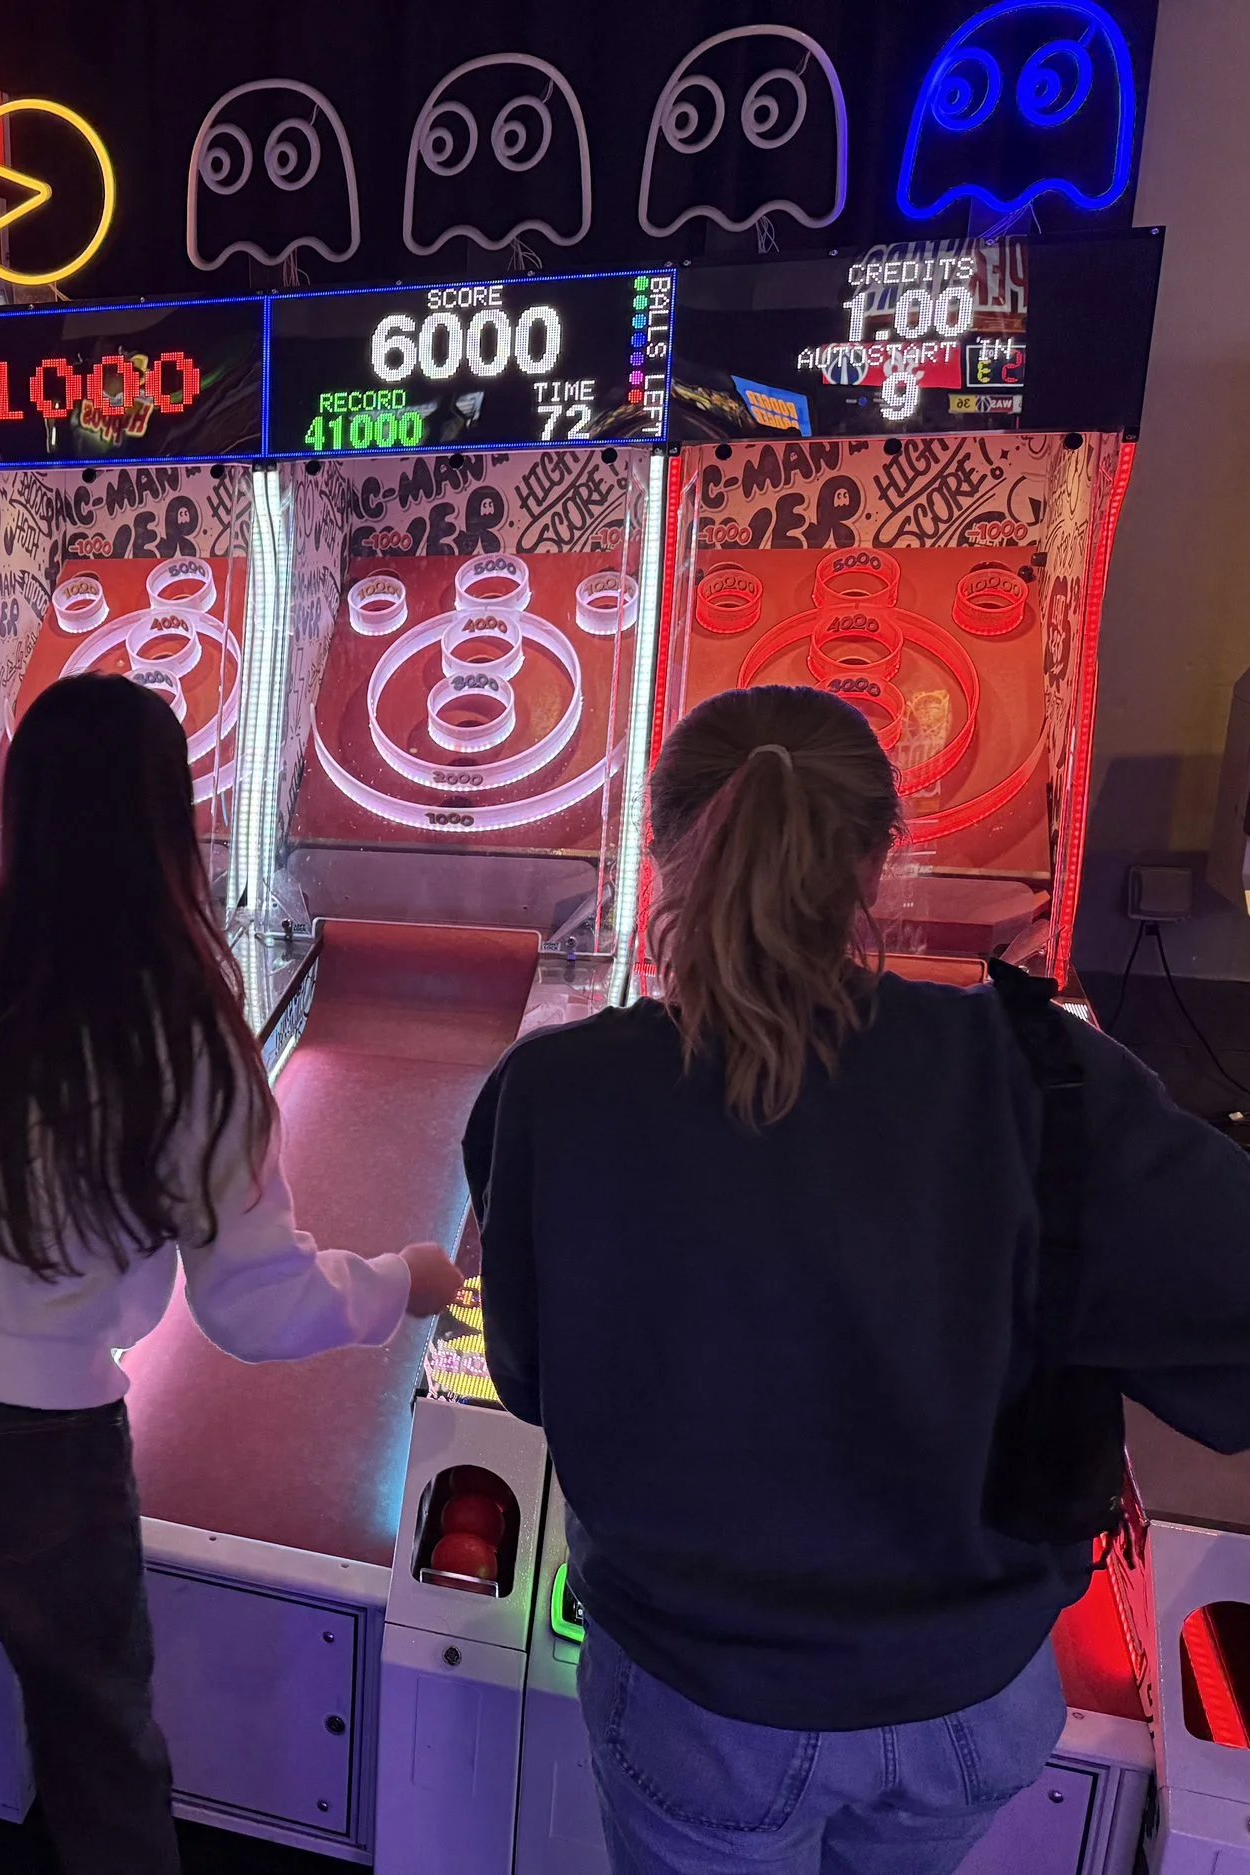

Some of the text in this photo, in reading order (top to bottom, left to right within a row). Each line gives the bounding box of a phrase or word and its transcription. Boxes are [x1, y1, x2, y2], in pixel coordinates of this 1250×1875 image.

[848, 257, 974, 286] CREDITS
[427, 285, 504, 308] SCORE
[842, 286, 974, 342] 1.00
[370, 305, 561, 382] 6000
[642, 276, 671, 437] BALLS LEFT
[797, 340, 957, 370] AUTOSTART
[318, 390, 407, 412] RECORD
[533, 379, 595, 403] TIME
[880, 371, 919, 421] 9
[304, 411, 423, 451] 41000
[535, 402, 591, 441] 72
[362, 529, 413, 551] -1000
[965, 519, 1029, 541] -1000
[68, 536, 112, 556] -1000
[168, 561, 206, 578] 5000
[473, 558, 517, 576] 5000
[832, 551, 882, 573] 5000
[150, 615, 189, 632] 4000
[461, 615, 508, 634] 4000
[826, 612, 880, 633] 4000
[431, 770, 484, 786] 2000
[425, 811, 474, 827] 1000
